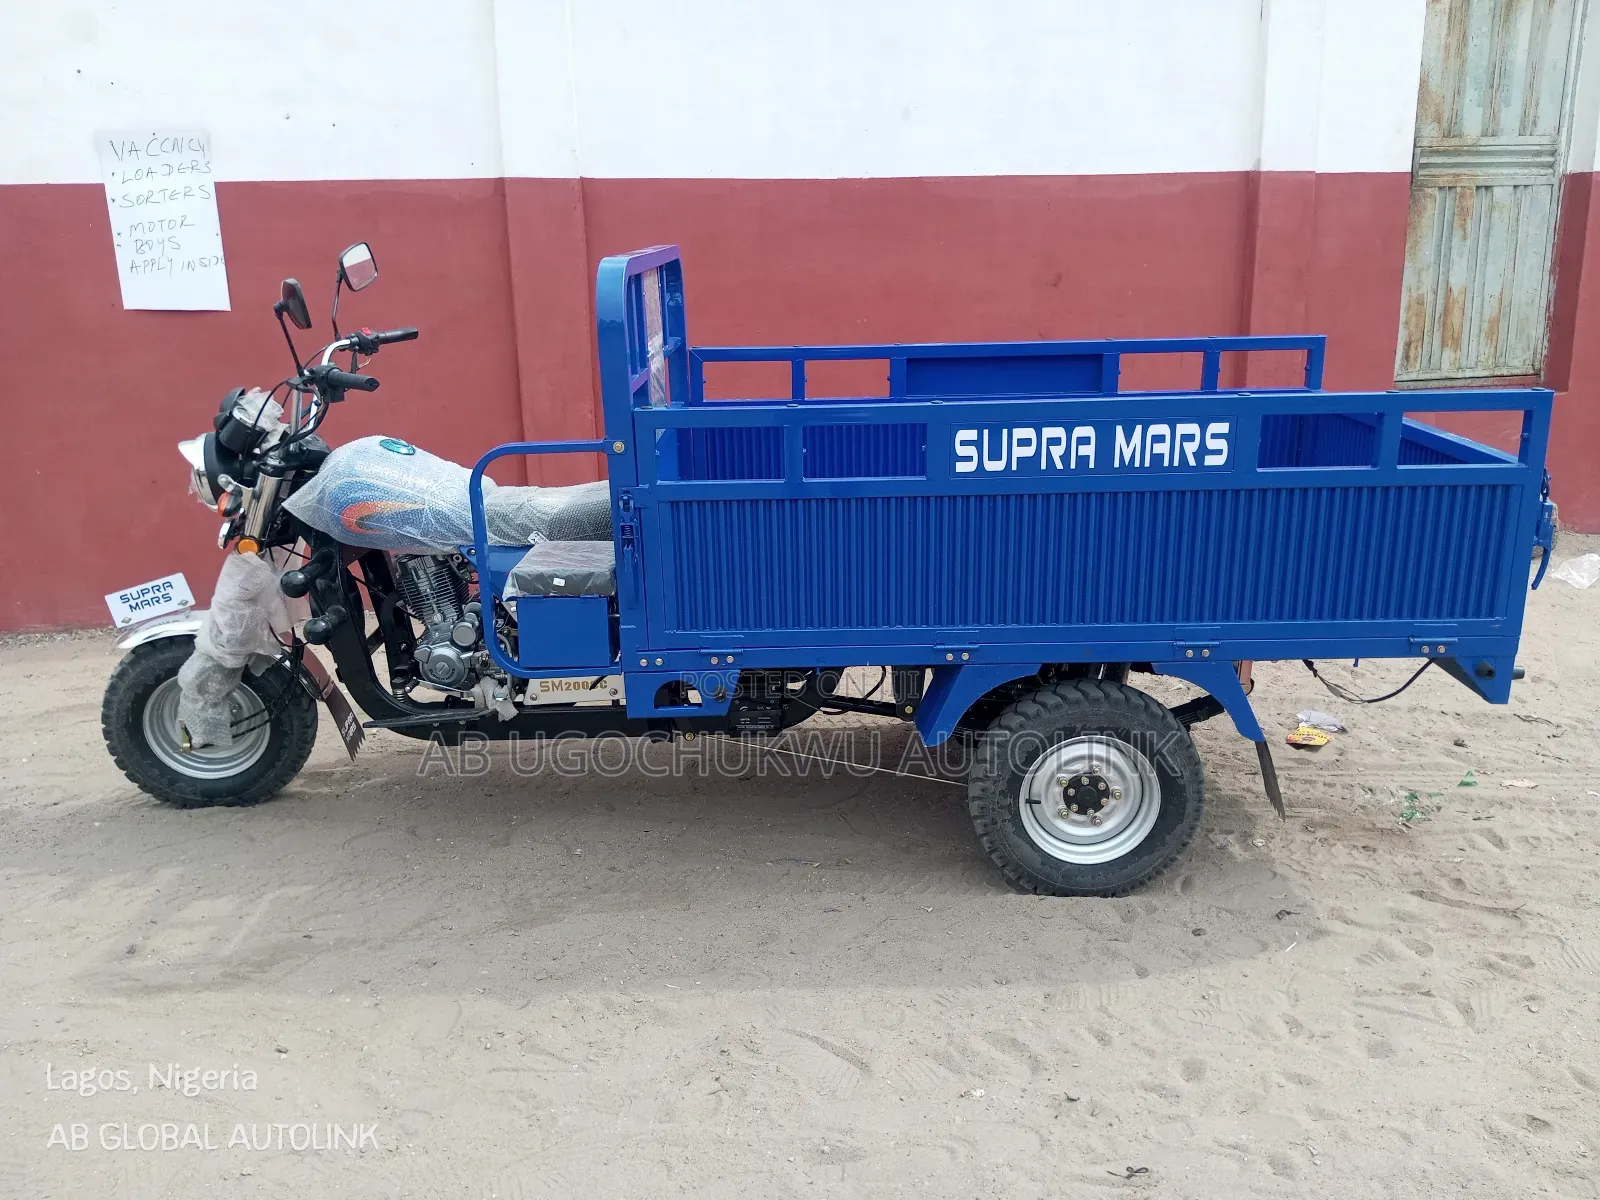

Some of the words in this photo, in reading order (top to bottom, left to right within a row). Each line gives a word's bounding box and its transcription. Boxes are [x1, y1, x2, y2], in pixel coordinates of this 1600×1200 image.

[122, 160, 212, 184] LOADERS
[119, 185, 211, 208] SORTERS
[129, 215, 195, 237] MOTOR
[134, 236, 181, 256] BOYS
[130, 257, 173, 277] APPLY
[955, 425, 1096, 472] SUPRA
[1114, 422, 1230, 469] MARS
[120, 581, 174, 604] SUPRA
[129, 593, 172, 613] MARS
